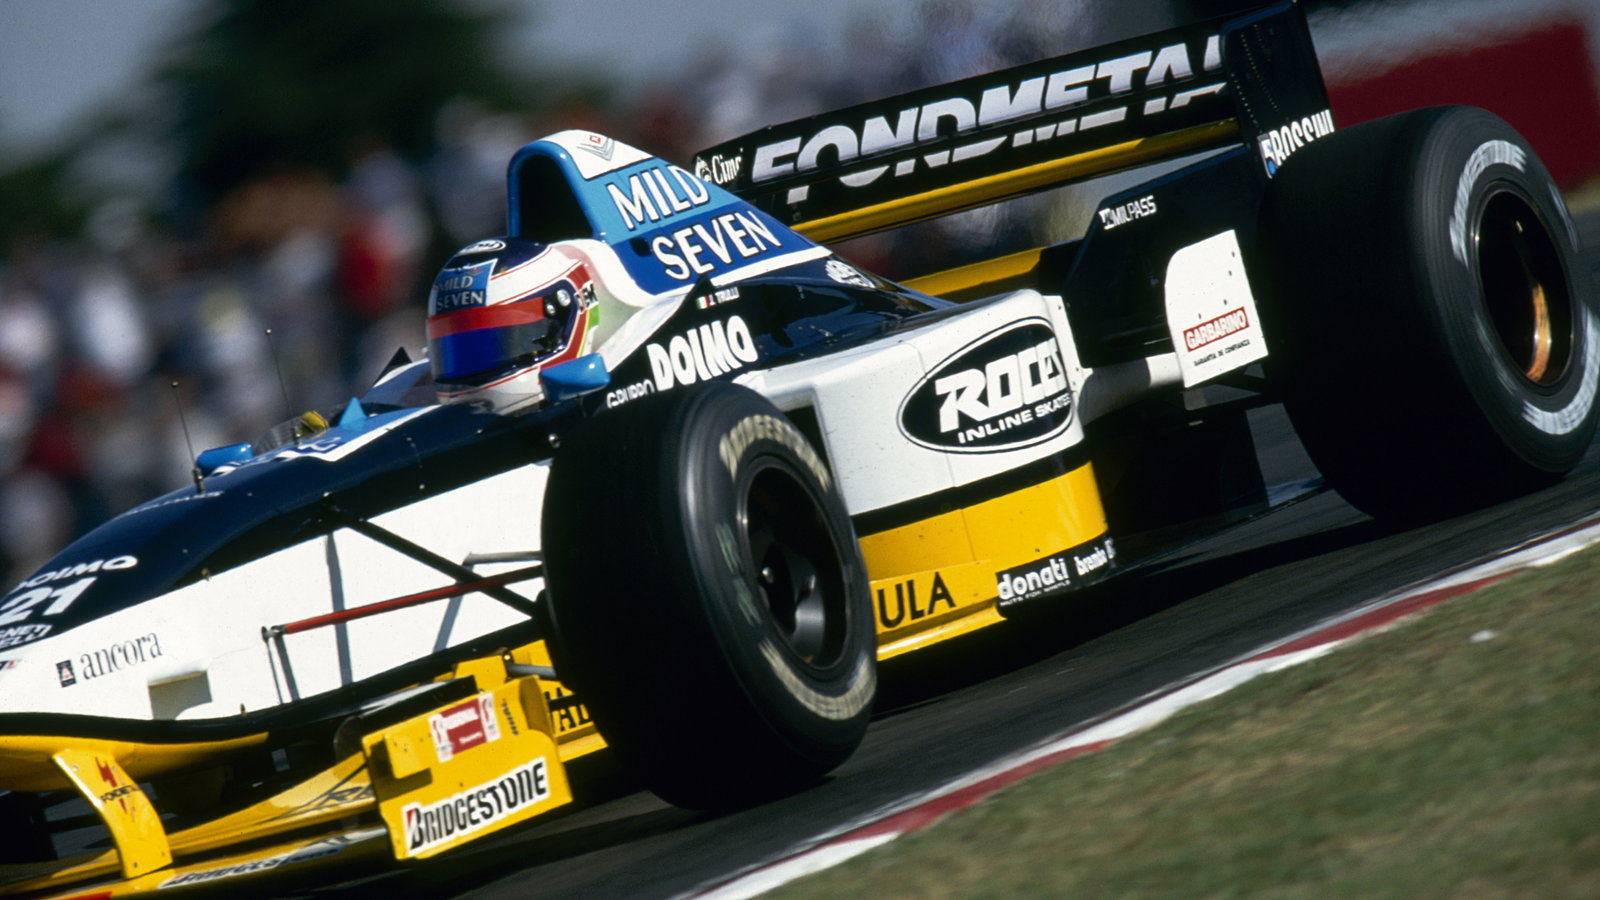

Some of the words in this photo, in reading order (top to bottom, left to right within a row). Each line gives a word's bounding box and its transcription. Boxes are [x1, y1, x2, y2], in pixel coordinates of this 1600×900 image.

[752, 34, 1227, 205] FONDMETAL
[605, 163, 710, 231] MILD
[651, 210, 783, 281] SEVEN
[437, 290, 484, 312] SEVEN
[646, 315, 758, 392] DOIMO
[1186, 309, 1247, 349] GARBARINO
[957, 409, 1034, 444] INLINE
[0, 576, 98, 626] 21
[997, 558, 1069, 600] donati
[80, 632, 163, 681] ancora
[405, 762, 547, 851] BRIDGESTONE
